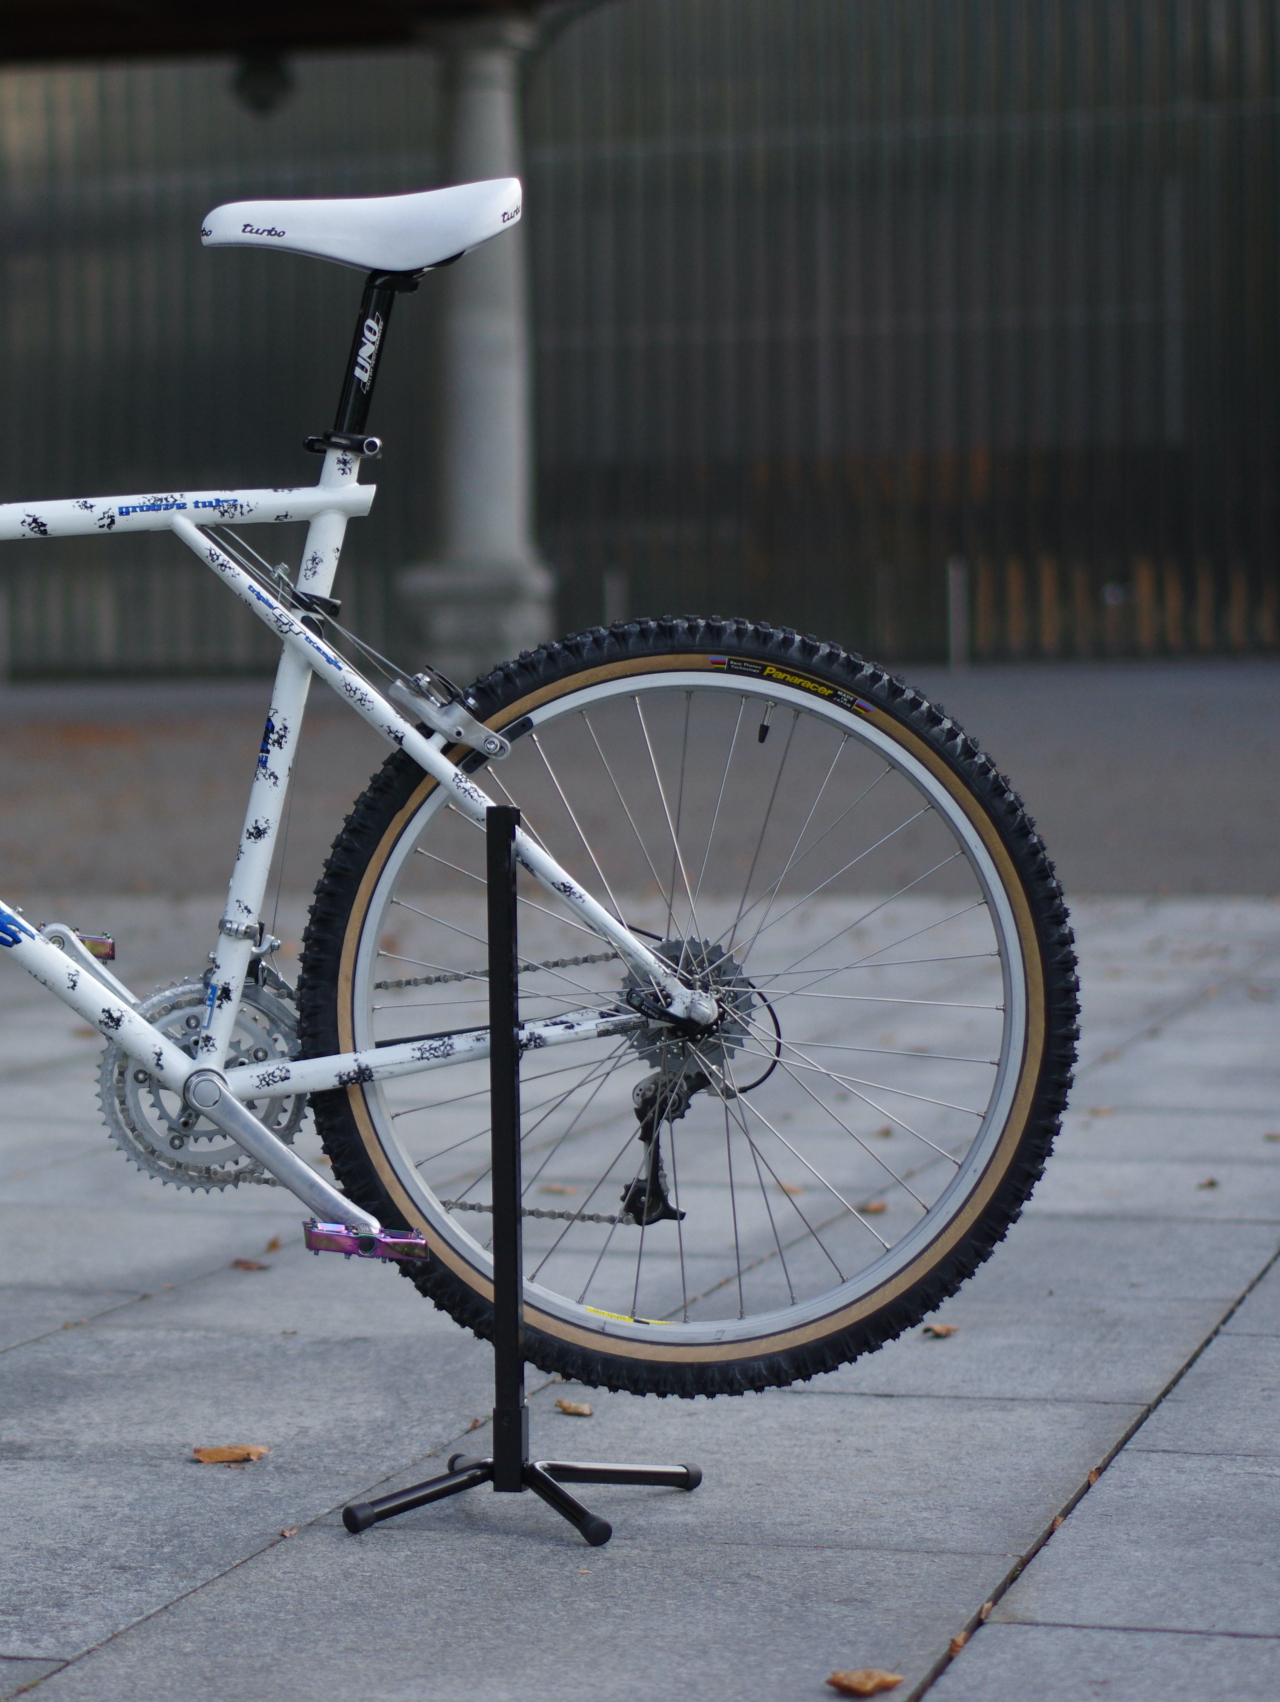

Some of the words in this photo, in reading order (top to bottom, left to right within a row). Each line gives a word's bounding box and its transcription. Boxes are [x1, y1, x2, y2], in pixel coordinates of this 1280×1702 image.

[501, 204, 521, 223] turb
[241, 223, 286, 238] turbo
[353, 318, 379, 383] UNO
[118, 502, 187, 516] groove
[271, 606, 307, 636] GT
[763, 666, 834, 697] Panaracer
[837, 690, 854, 701] MADE
